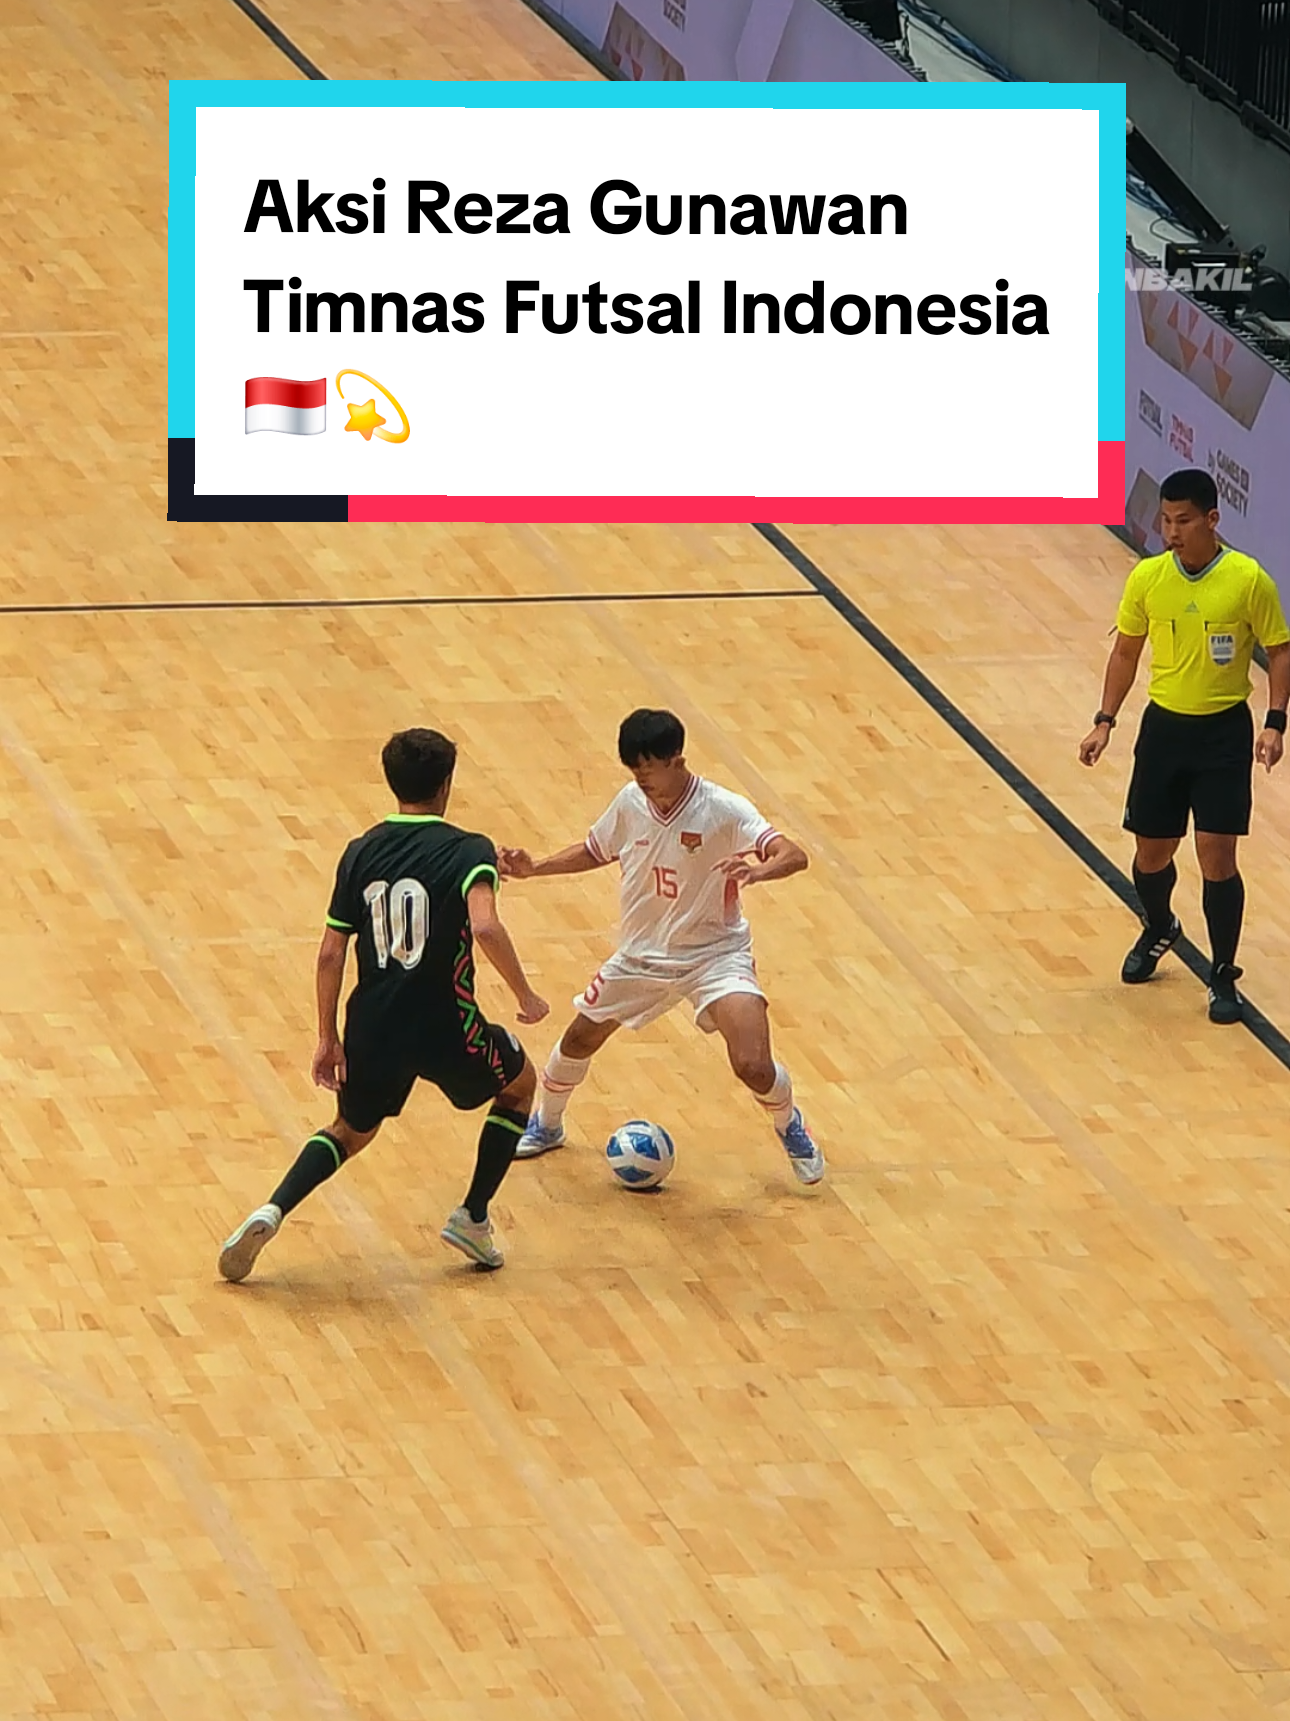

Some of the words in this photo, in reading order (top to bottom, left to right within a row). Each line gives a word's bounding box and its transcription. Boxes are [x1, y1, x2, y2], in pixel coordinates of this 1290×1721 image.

[1216, 472, 1249, 518] SOCIETY
[1211, 635, 1234, 644] FIFA
[652, 866, 678, 899] 15
[363, 878, 430, 970] 10
